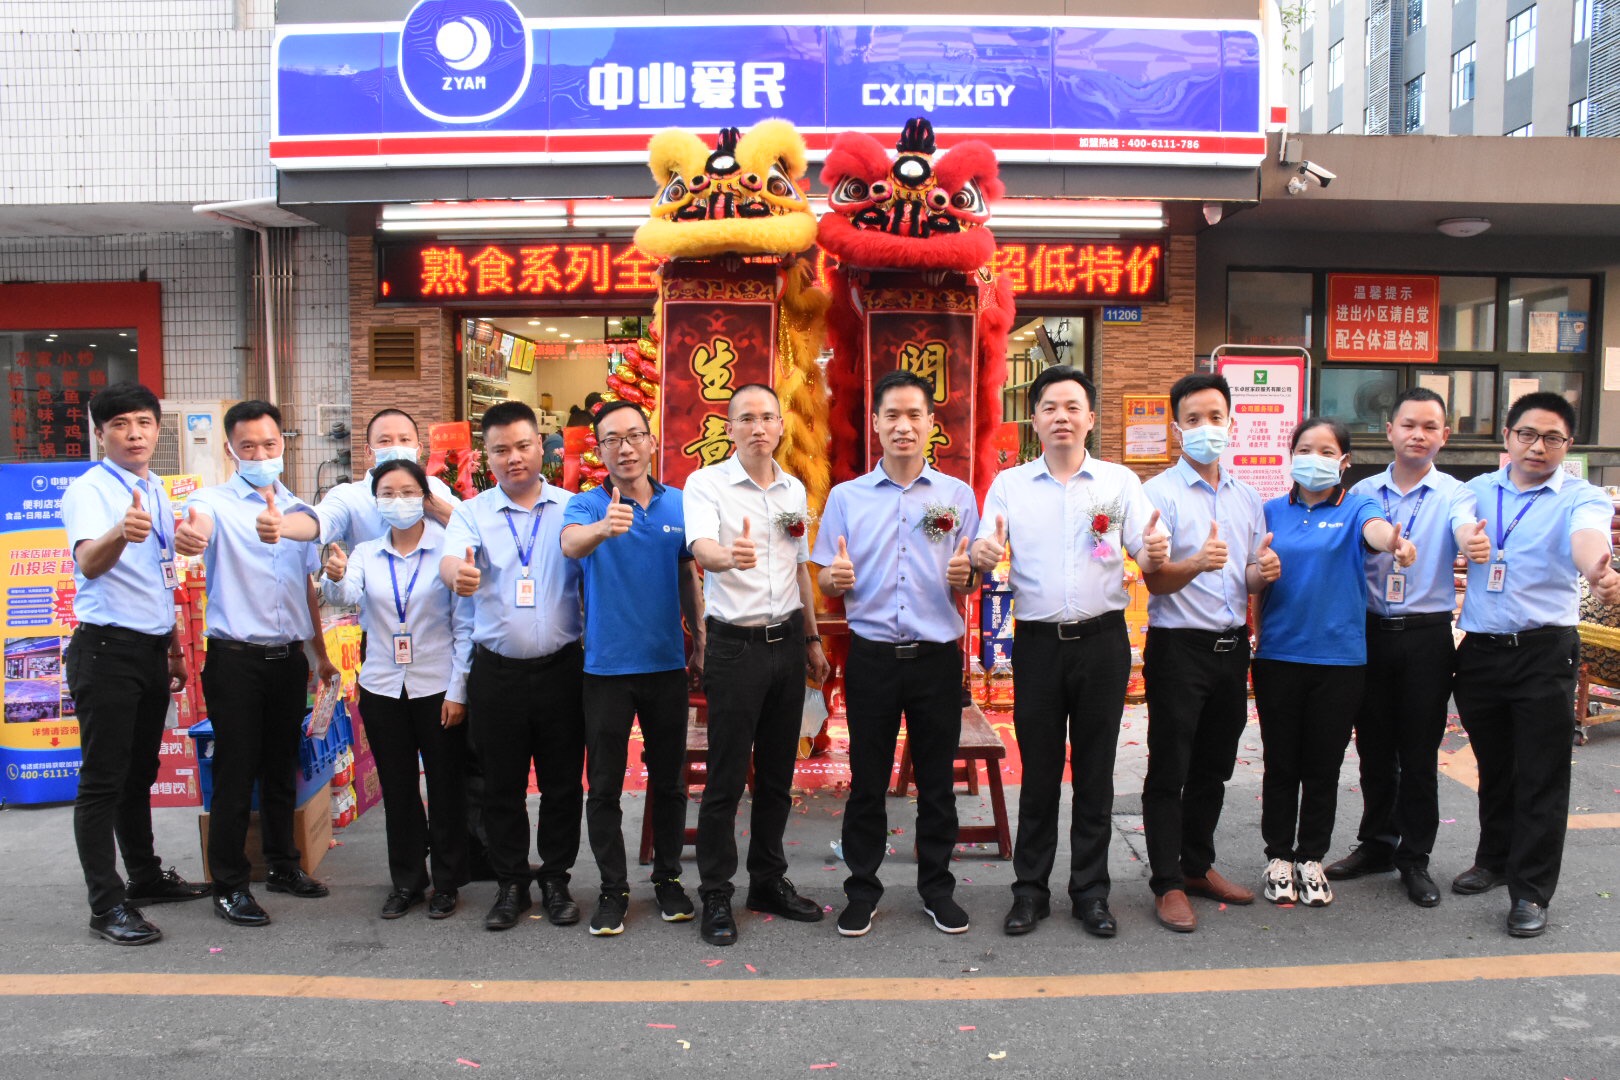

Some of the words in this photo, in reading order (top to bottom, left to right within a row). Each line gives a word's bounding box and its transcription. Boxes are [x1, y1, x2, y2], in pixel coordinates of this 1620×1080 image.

[442, 76, 486, 90] ZYAM
[588, 61, 787, 111] 中业爱民
[420, 244, 660, 294] 熟食系列全
[1354, 285, 1413, 300] 温馨提示
[1106, 309, 1138, 321] 11206
[1336, 304, 1429, 323] 进出小区请自觉
[1335, 328, 1429, 351] 配合体温检测
[1127, 400, 1165, 416] 招聘
